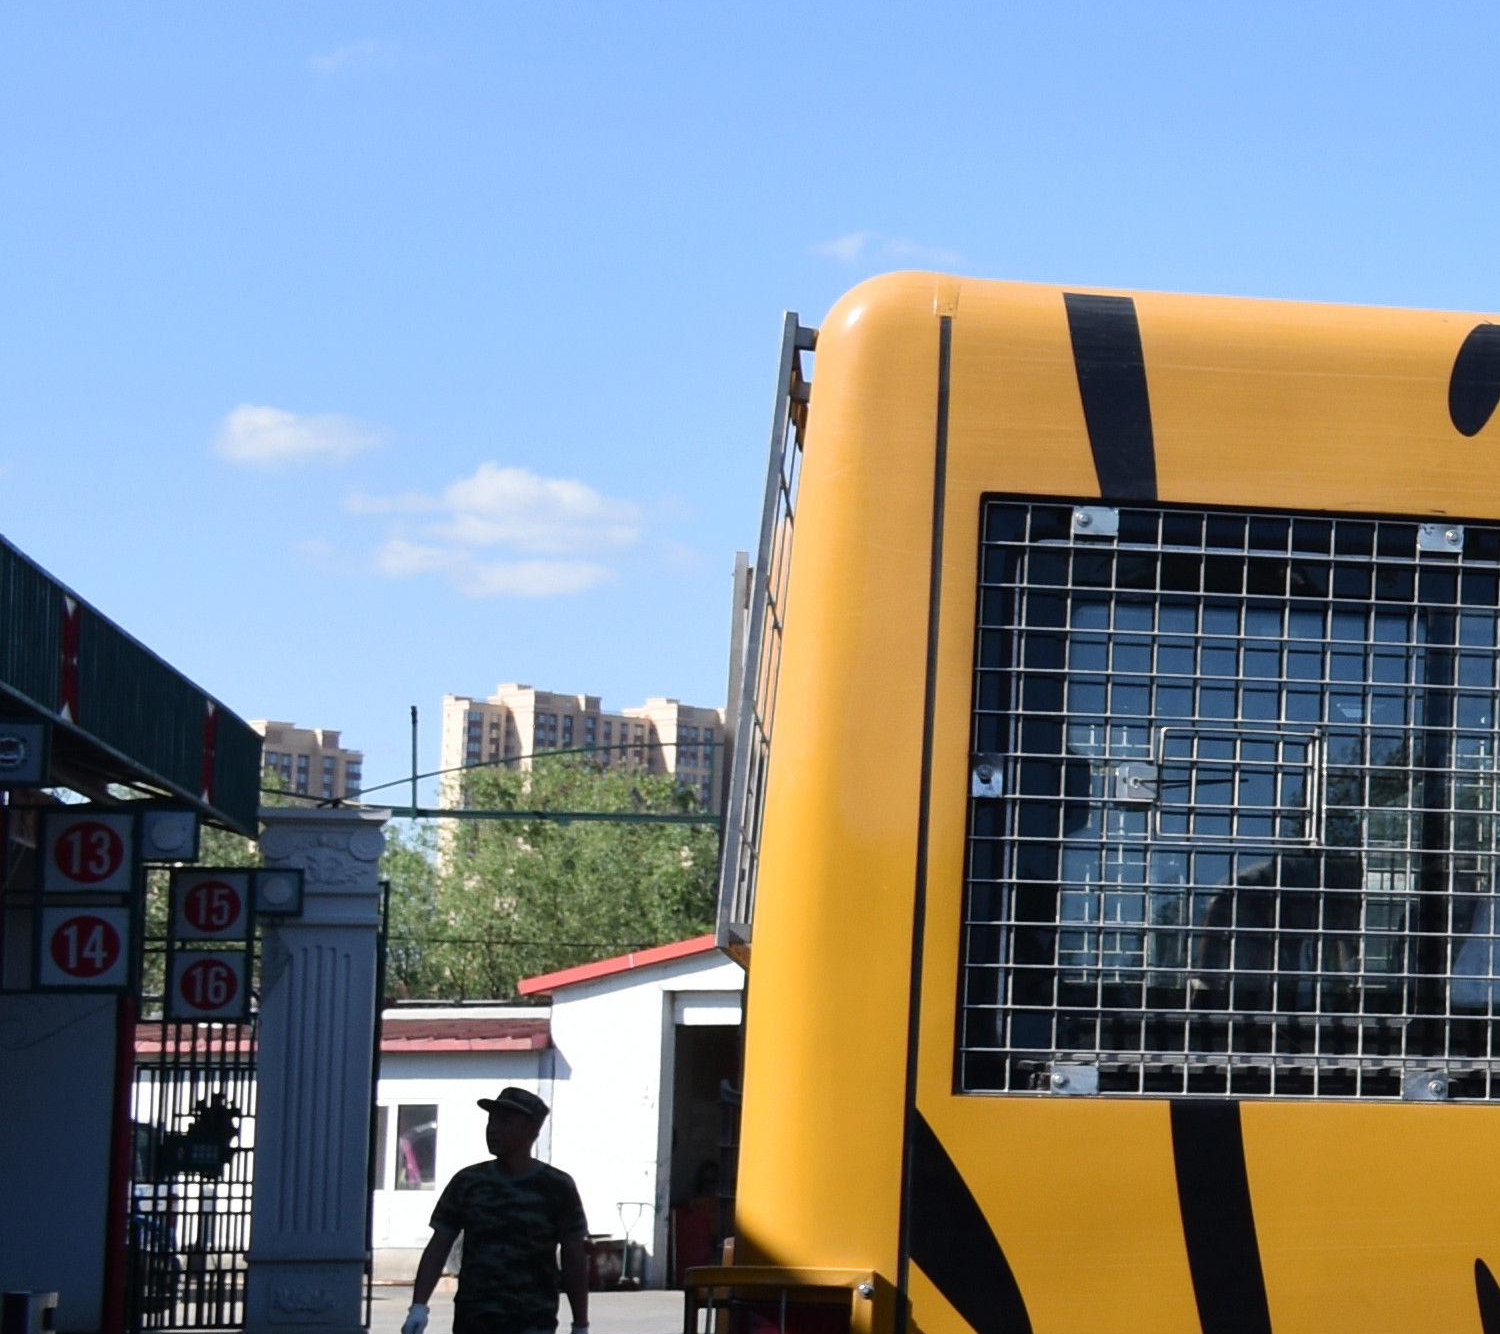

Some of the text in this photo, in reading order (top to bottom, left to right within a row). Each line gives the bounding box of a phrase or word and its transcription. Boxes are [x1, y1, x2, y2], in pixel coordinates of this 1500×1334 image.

[67, 828, 111, 876] 13
[195, 888, 230, 926] 15
[63, 924, 108, 969] 14
[192, 966, 228, 1003] 16
